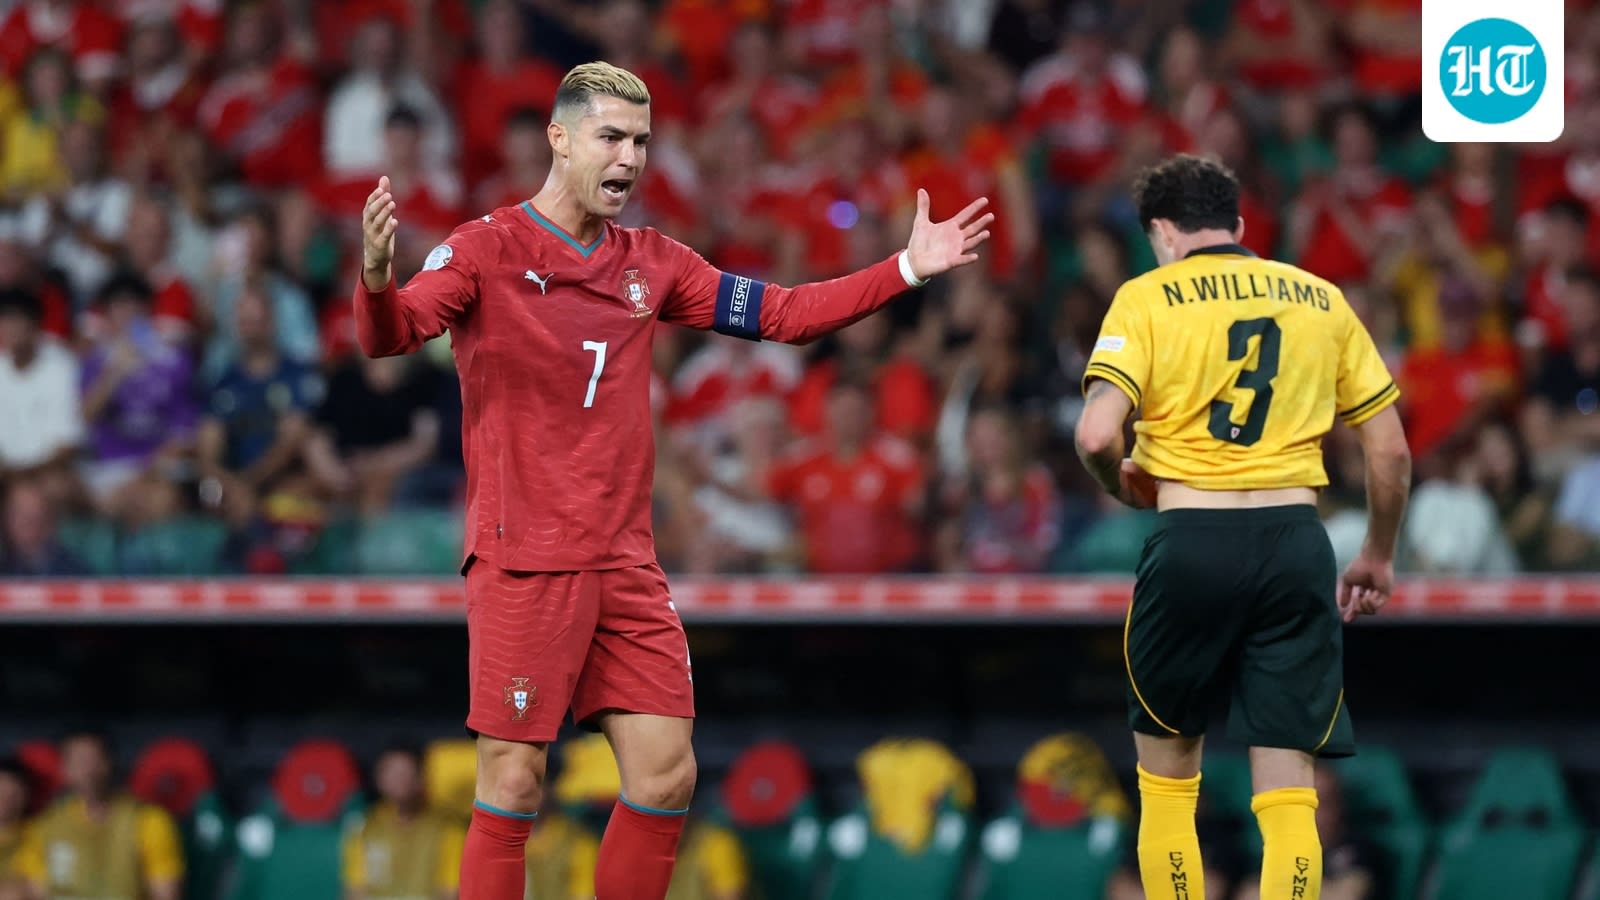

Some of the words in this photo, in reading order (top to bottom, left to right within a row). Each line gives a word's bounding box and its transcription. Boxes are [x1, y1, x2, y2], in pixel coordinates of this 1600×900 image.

[1161, 273, 1331, 312] N.WILLIAMS
[582, 340, 608, 408] 7
[1206, 316, 1282, 448] 3
[1291, 856, 1310, 900] CYMR
